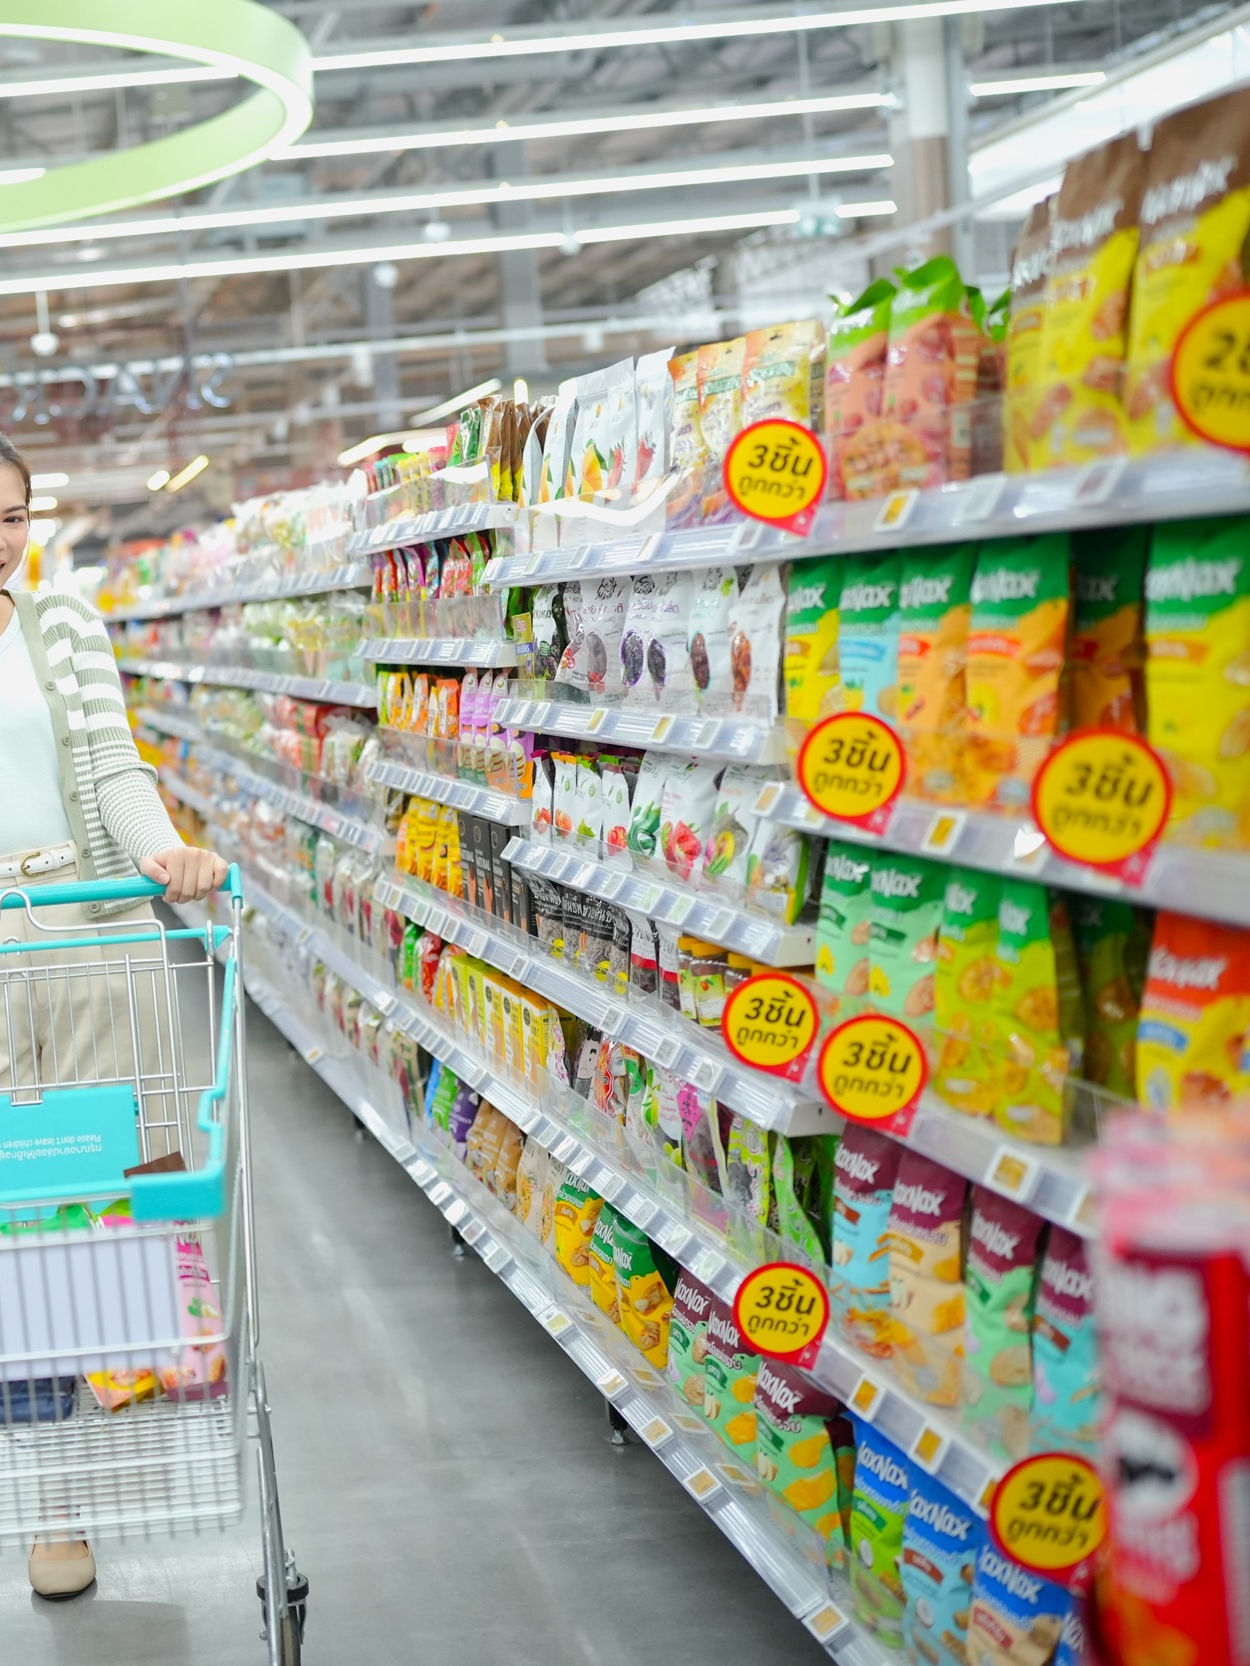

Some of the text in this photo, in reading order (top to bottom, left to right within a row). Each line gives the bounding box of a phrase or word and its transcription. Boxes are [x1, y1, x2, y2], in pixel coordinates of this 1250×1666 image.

[748, 437, 815, 477] 3ชิ้น
[824, 730, 892, 773] 3ชิ้น
[744, 990, 806, 1028] 3ชิ้น
[843, 1034, 912, 1075] 3ชิ้น
[2, 1139, 33, 1149] children
[34, 1138, 54, 1146] leave
[55, 1136, 75, 1145] don't
[76, 1134, 101, 1143] Please
[755, 1278, 815, 1315] 3ชิ้น
